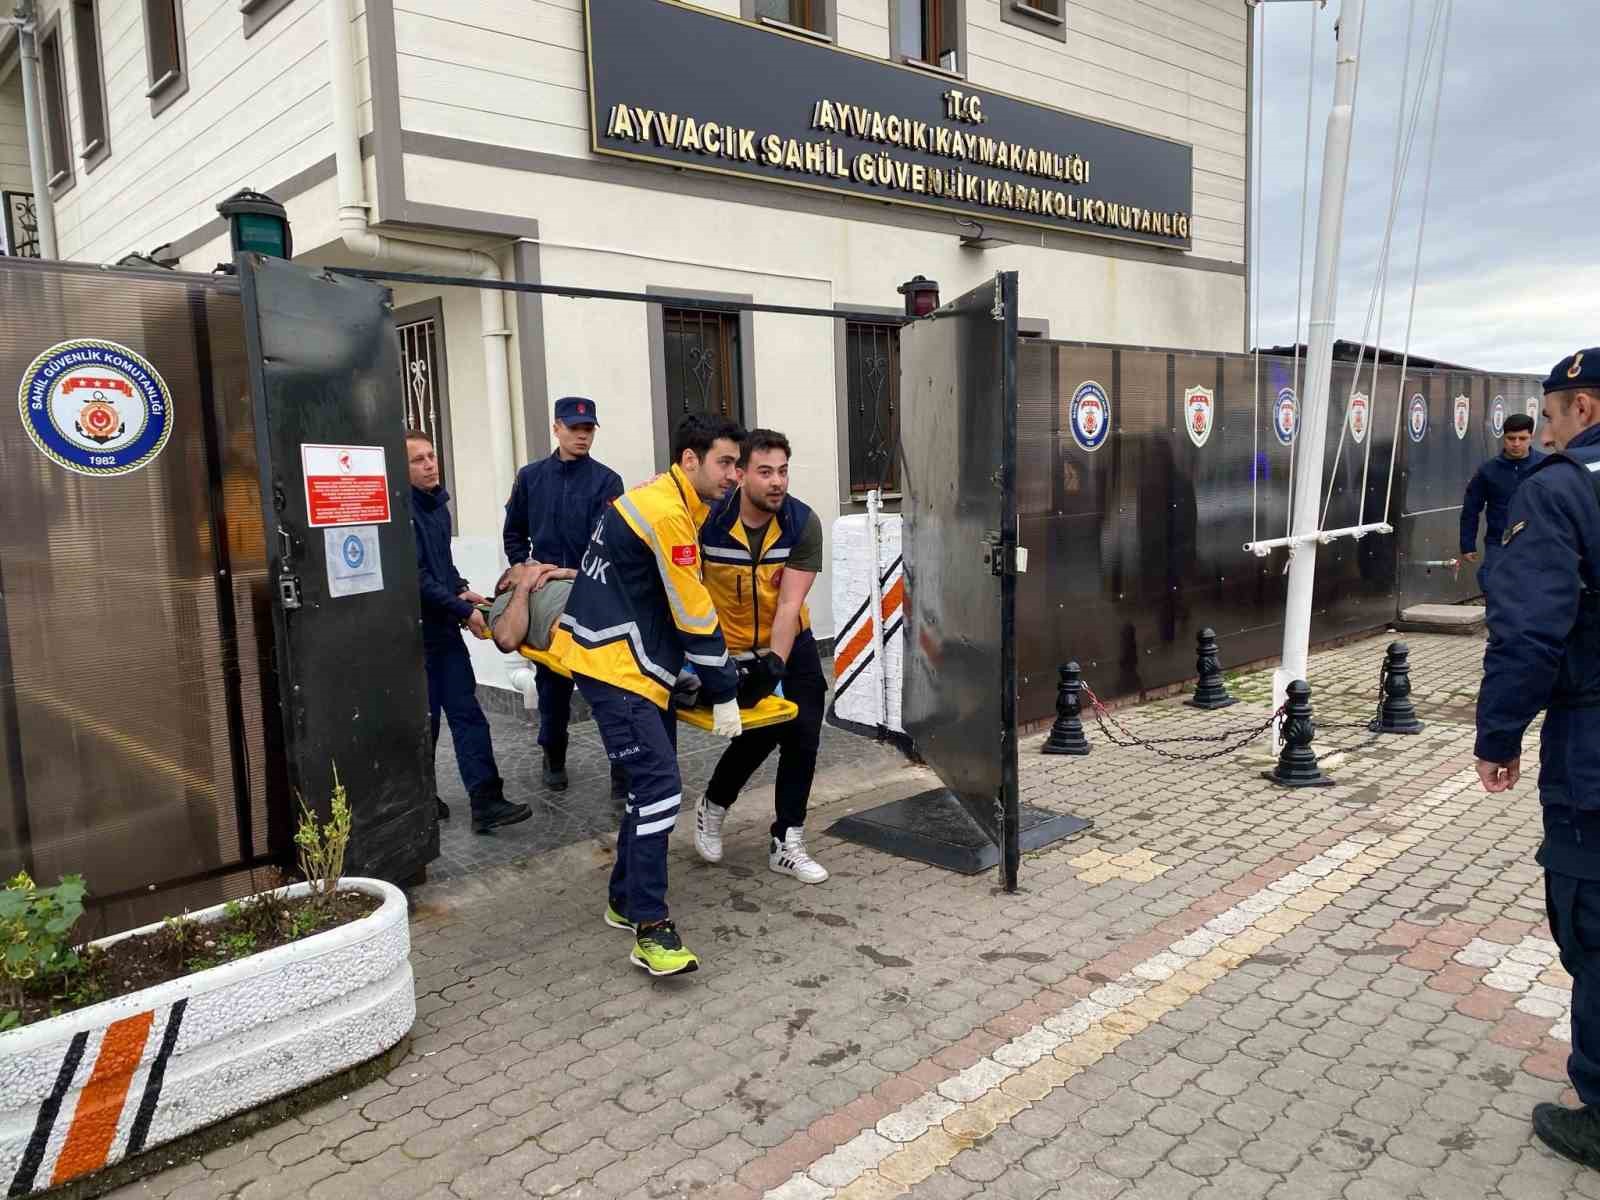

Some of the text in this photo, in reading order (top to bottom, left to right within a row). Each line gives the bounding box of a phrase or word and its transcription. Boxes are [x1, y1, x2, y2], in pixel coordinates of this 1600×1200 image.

[608, 104, 757, 160] AYVACIK
[762, 134, 850, 177] SAHİL
[857, 152, 979, 201] GÜVENLİK
[987, 177, 1077, 218] KARAKOL
[813, 99, 1090, 183] AYVACIK KAYMAKAMLIĞI
[32, 350, 164, 415] SAHİL GÜVENLİK KOMUTANLIĞI
[89, 456, 116, 465] 1982
